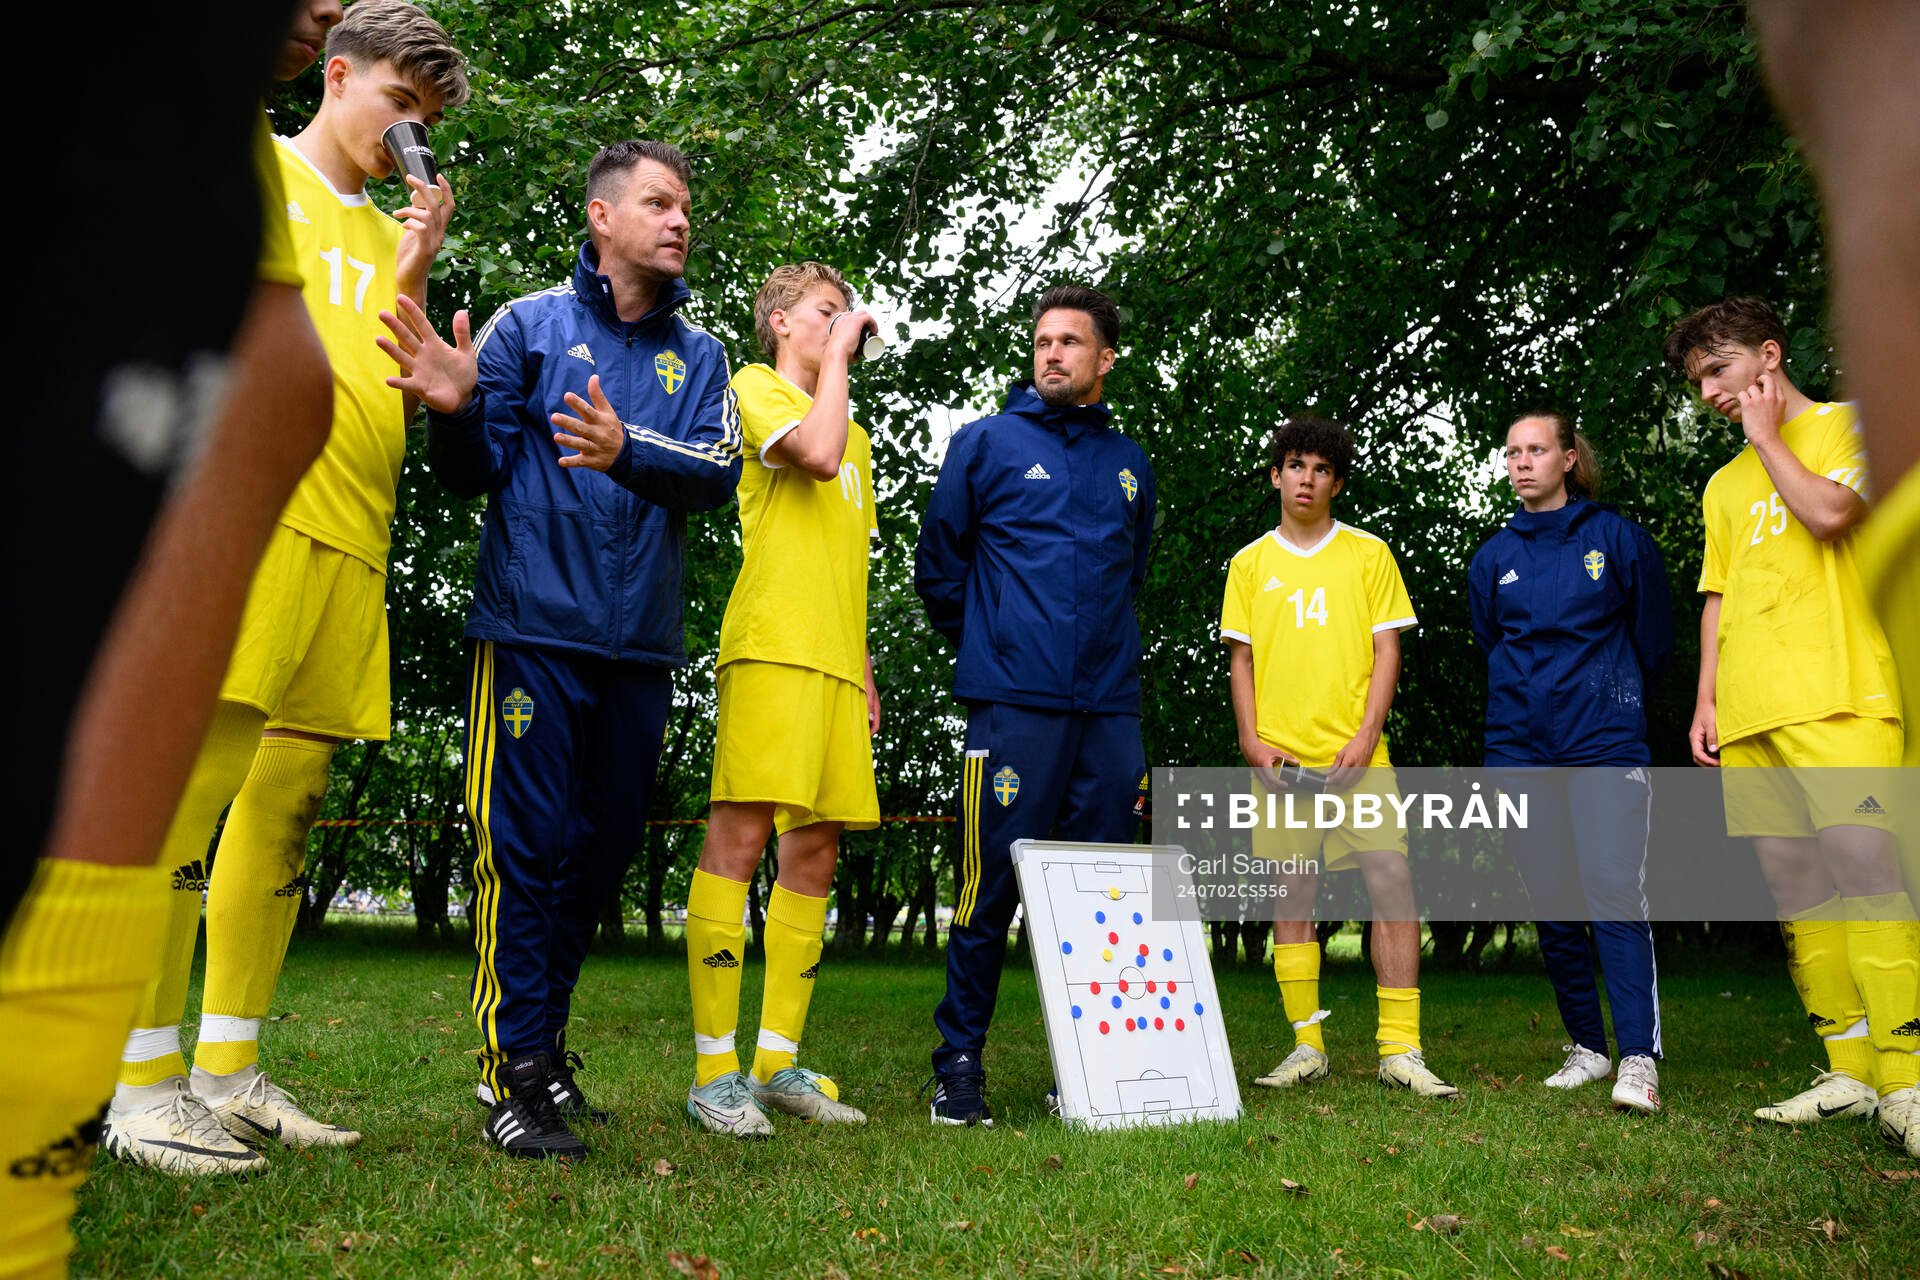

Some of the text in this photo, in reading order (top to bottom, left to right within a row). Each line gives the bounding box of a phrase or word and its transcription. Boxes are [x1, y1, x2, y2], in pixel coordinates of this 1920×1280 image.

[319, 246, 376, 316] 17
[567, 349, 595, 366] adidas
[838, 461, 863, 510] 10
[1750, 491, 1788, 547] 25
[1287, 586, 1329, 629] 14
[1854, 806, 1886, 815] adidas
[702, 957, 740, 969] adidas
